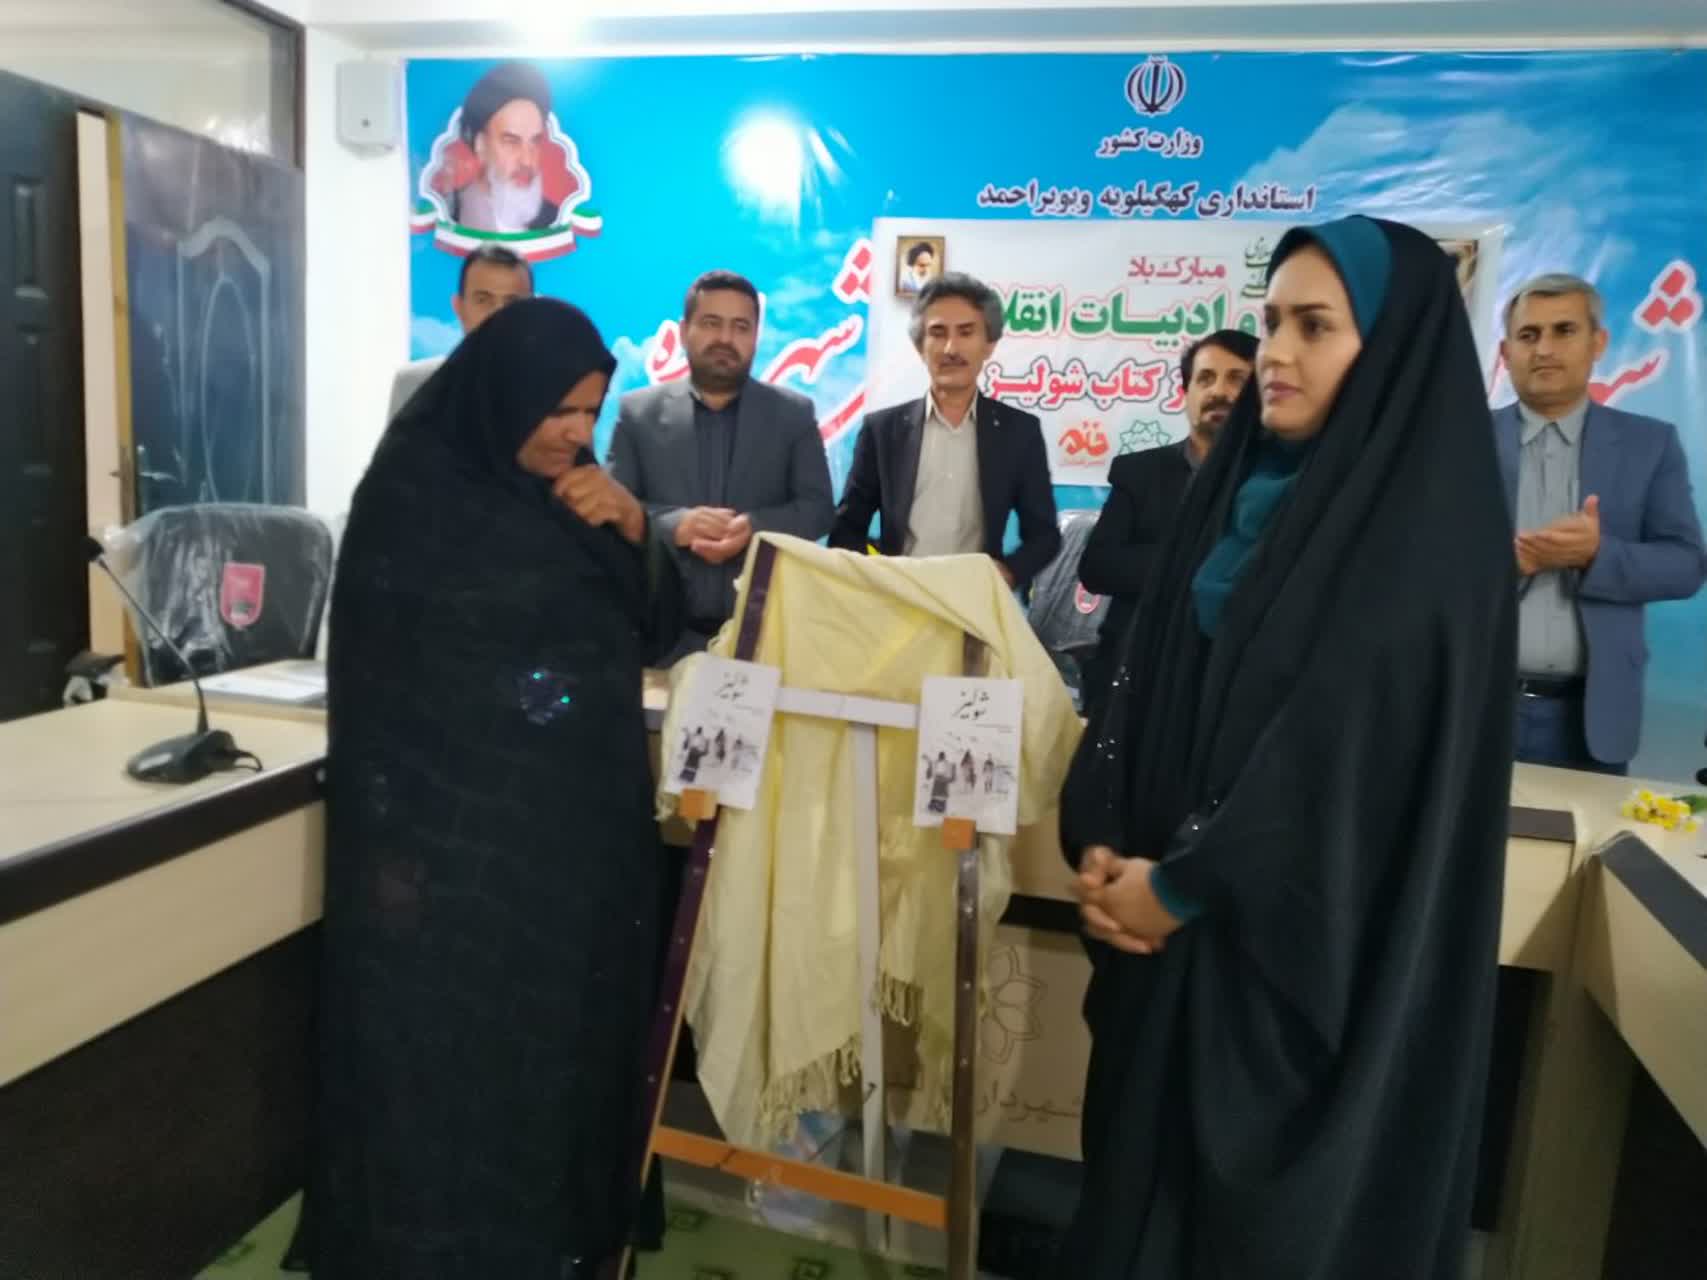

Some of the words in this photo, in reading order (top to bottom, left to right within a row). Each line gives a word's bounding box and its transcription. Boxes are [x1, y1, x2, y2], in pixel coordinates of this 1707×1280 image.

[1098, 129, 1145, 156] کشور
[1150, 132, 1203, 155] وزارت
[1100, 183, 1195, 212] کهگیلویه
[1199, 185, 1315, 217] استانداری
[1091, 365, 1161, 405] کتاب
